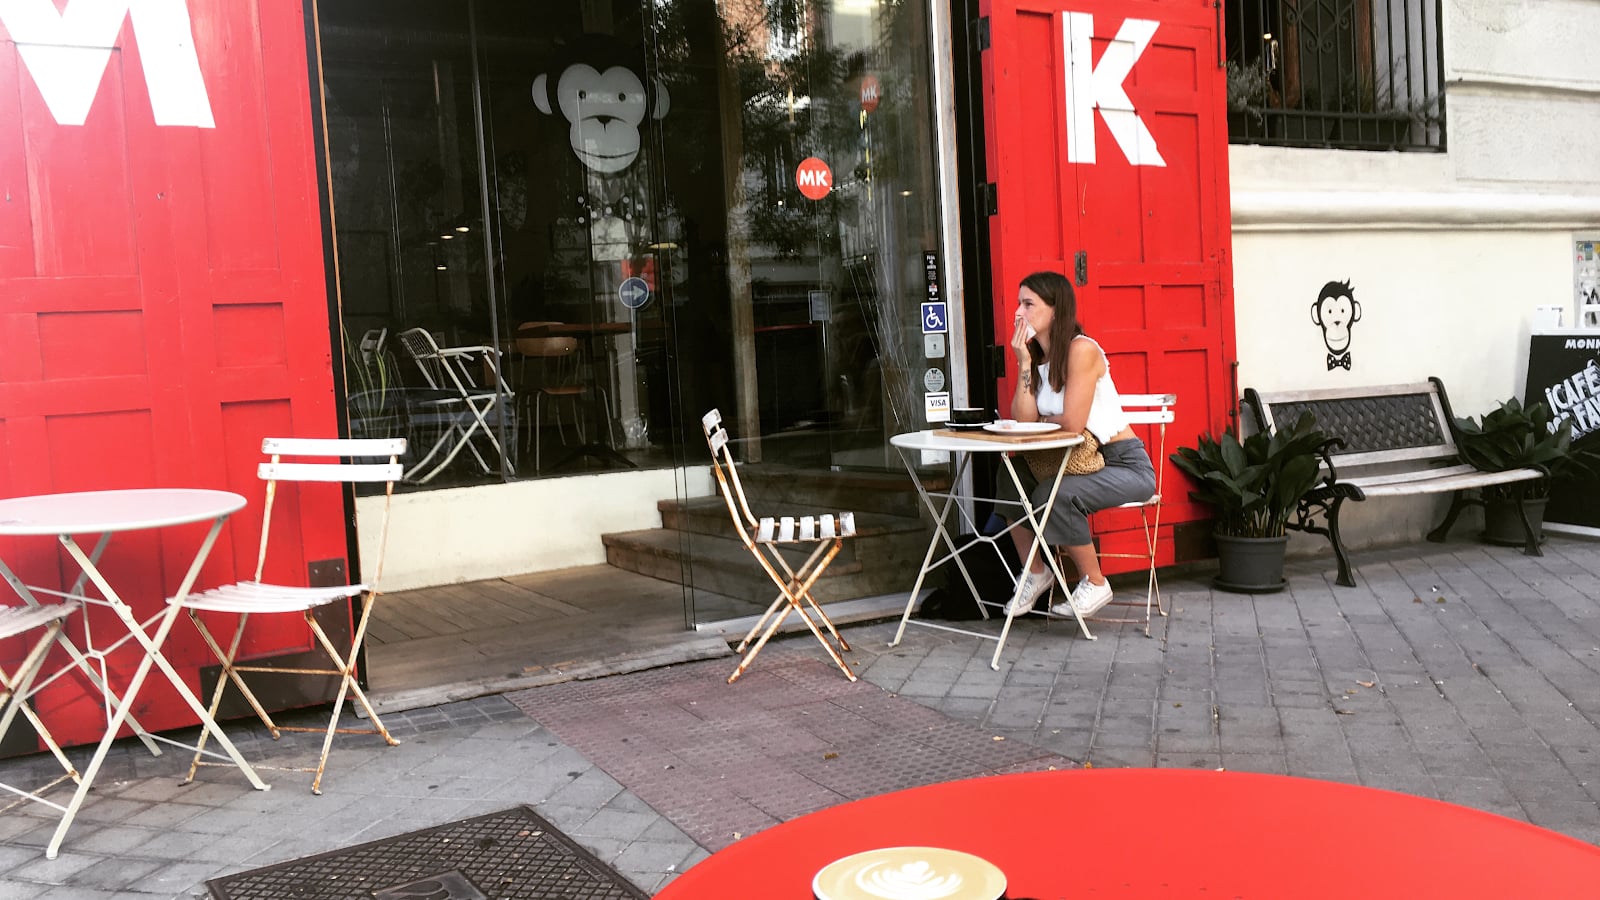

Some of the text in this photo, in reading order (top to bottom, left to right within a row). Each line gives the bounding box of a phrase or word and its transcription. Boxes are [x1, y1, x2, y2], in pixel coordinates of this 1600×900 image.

[861, 85, 877, 102] MK
[1062, 10, 1167, 167] K
[799, 169, 828, 187] MK
[930, 399, 946, 407] VISA
